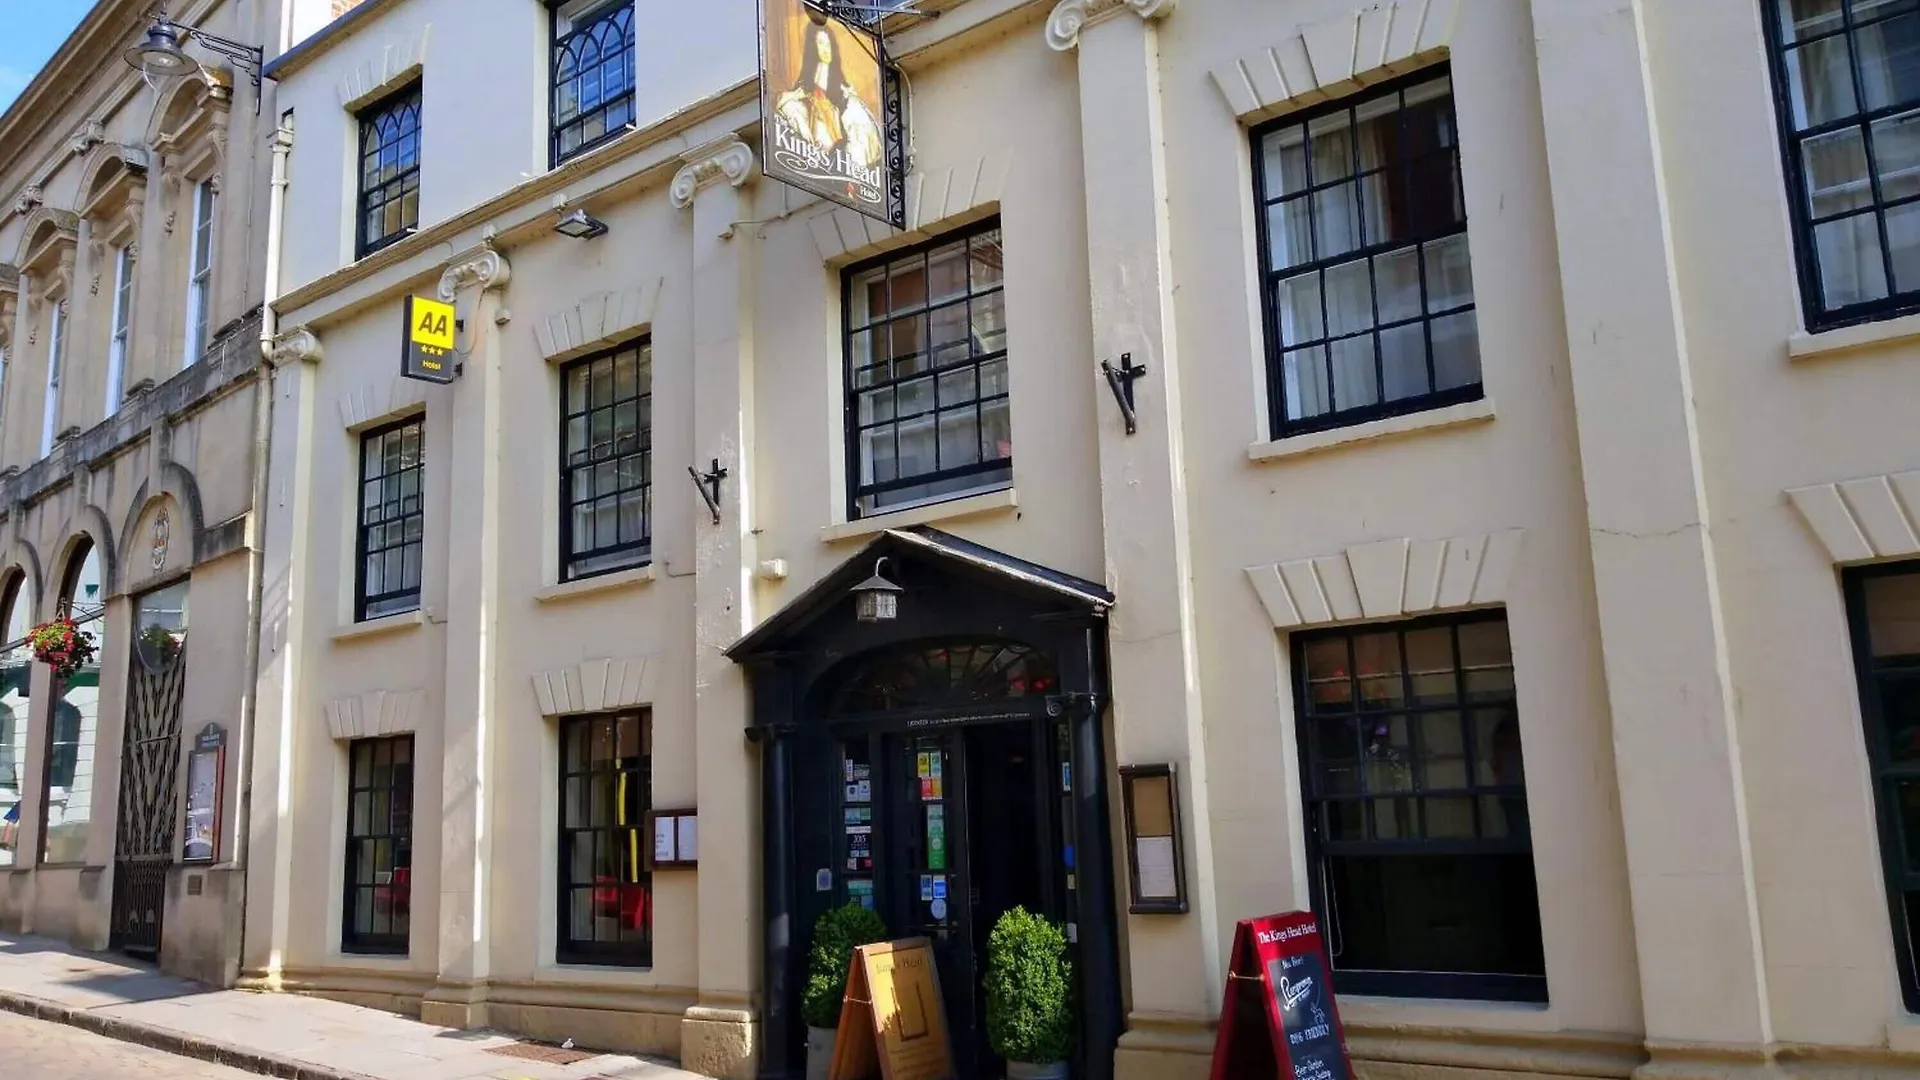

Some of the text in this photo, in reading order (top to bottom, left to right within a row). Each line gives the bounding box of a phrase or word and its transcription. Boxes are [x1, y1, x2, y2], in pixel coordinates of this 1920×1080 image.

[835, 148, 881, 189] Head
[418, 311, 447, 337] AA
[422, 359, 441, 370] Hotel
[1258, 922, 1317, 944] The Kings Head Hotel
